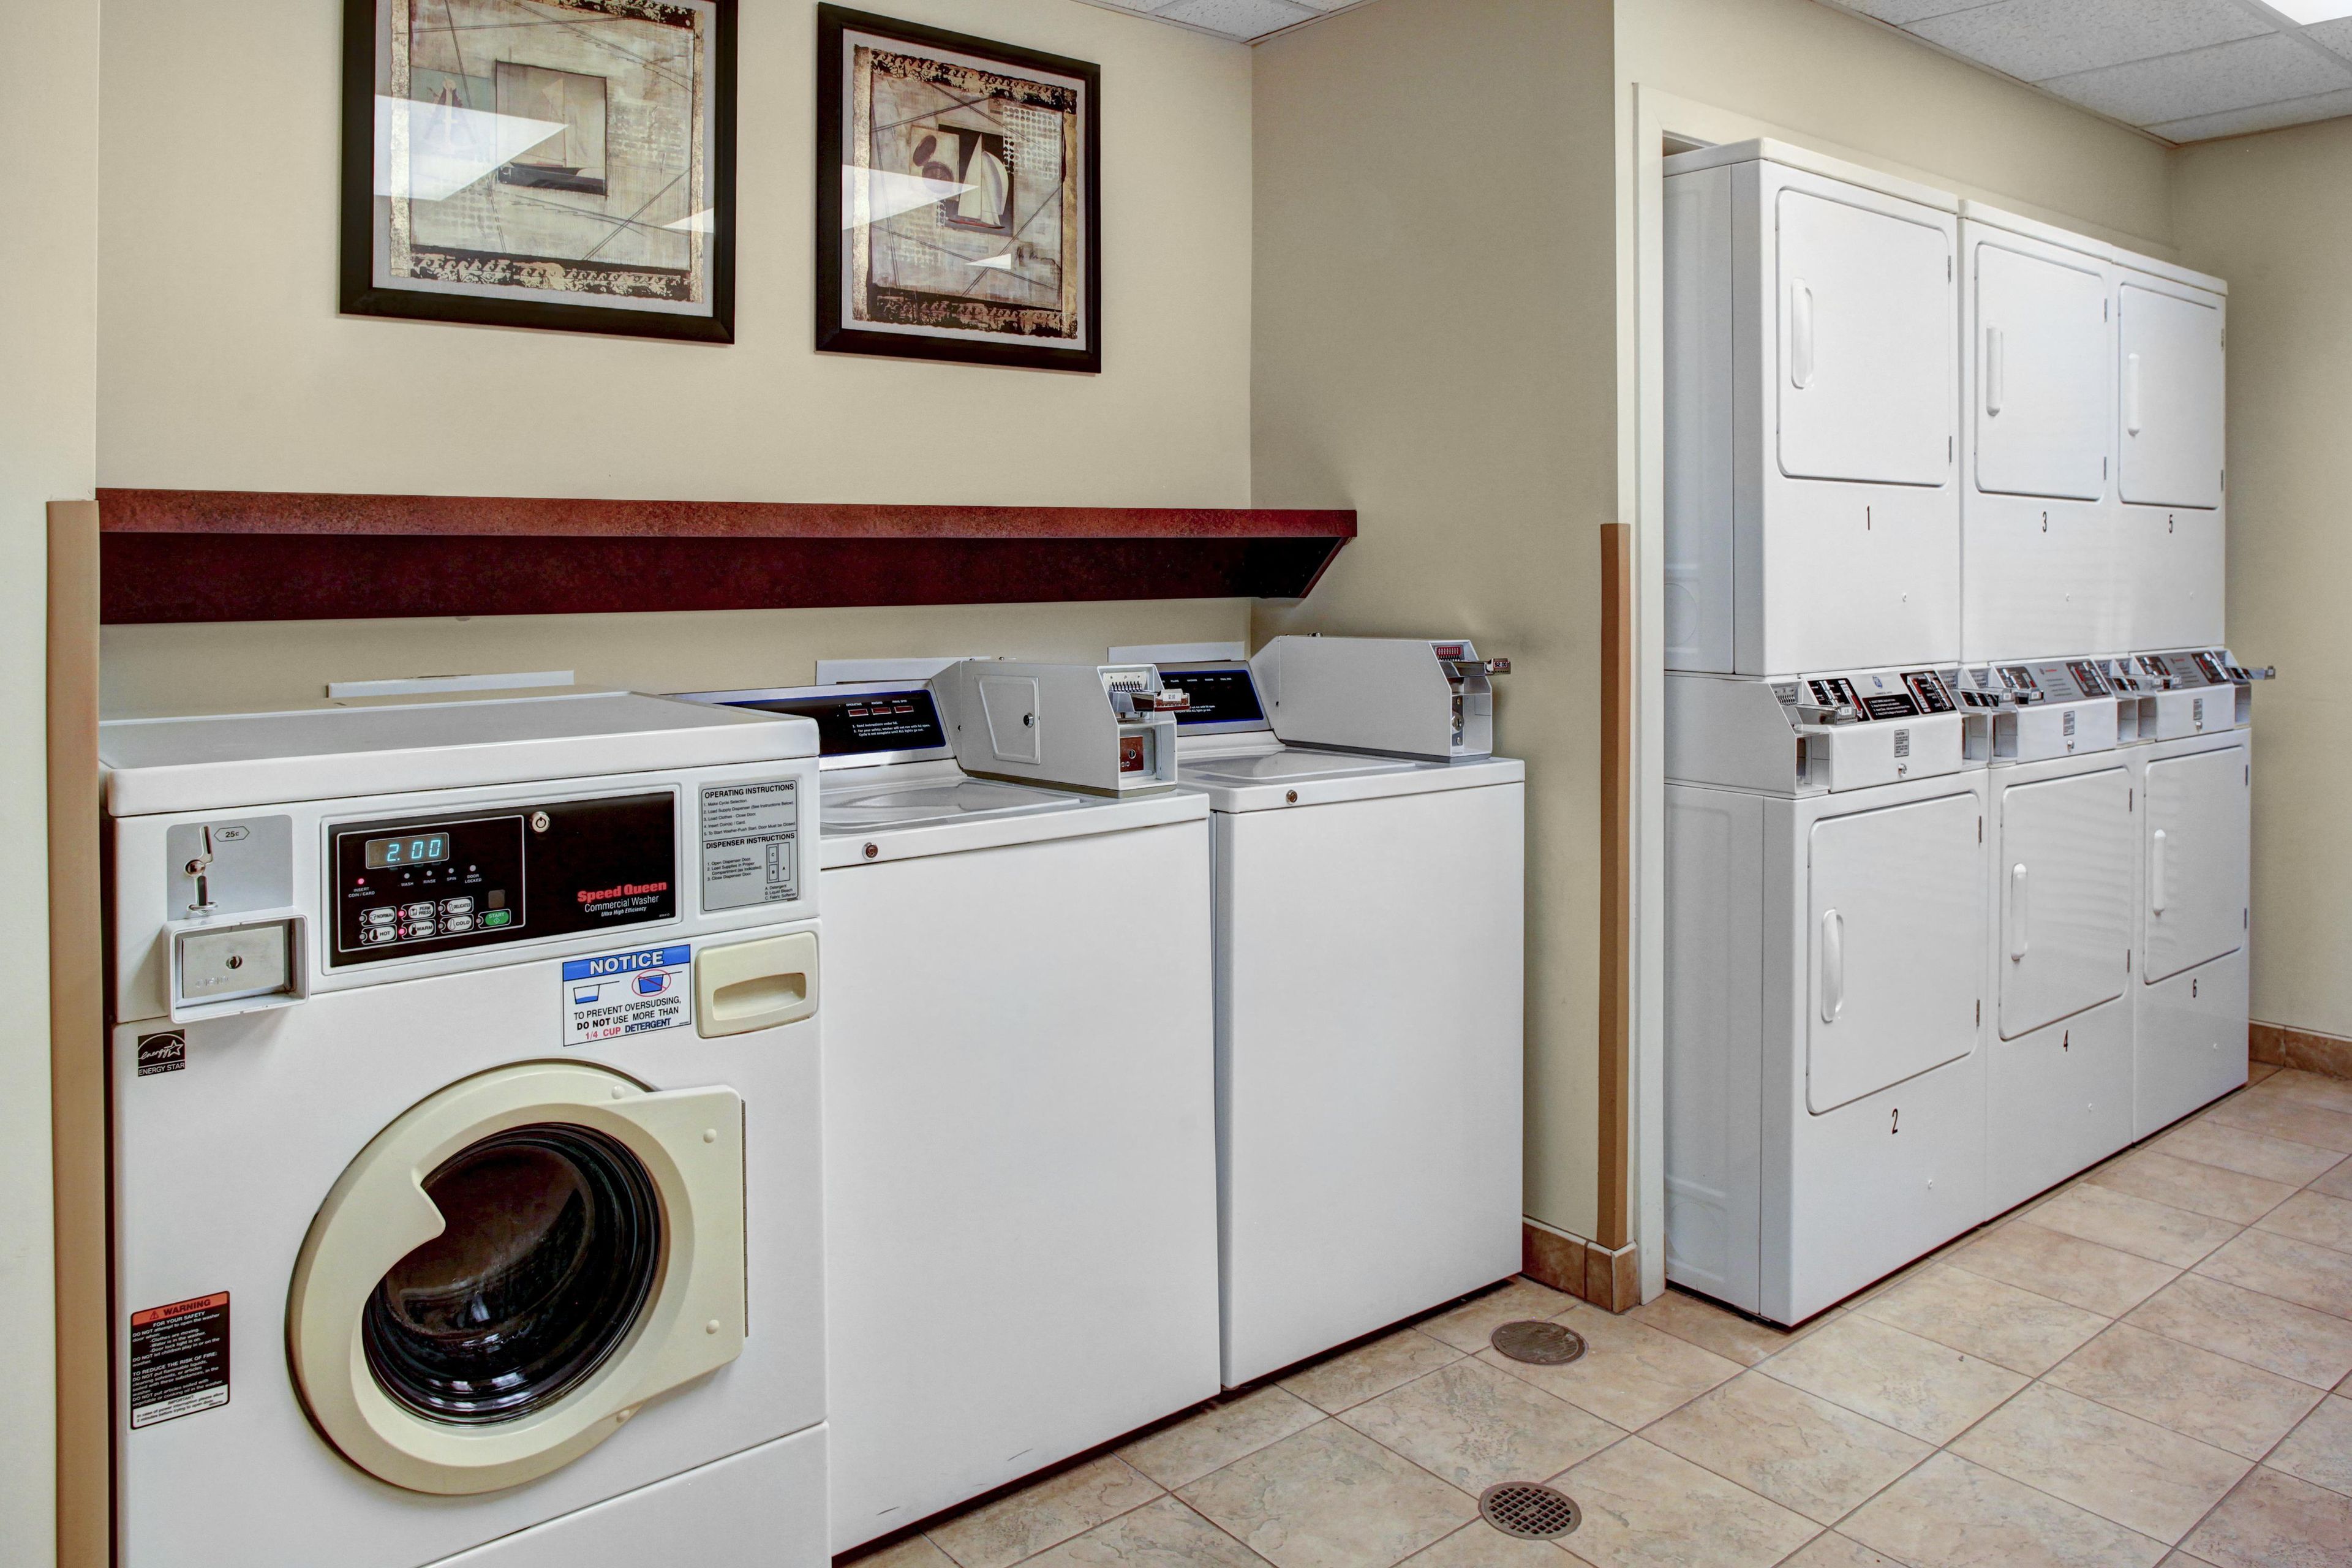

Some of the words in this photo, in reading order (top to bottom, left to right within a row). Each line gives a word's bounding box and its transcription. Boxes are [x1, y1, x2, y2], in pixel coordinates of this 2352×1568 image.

[1866, 505, 1871, 531] 1
[2042, 511, 2048, 533] 3
[2168, 514, 2173, 533] 5
[705, 789, 744, 799] OPERATING
[746, 783, 794, 794] INSTRUCTIONS
[706, 839, 745, 849] DISPENSER
[747, 833, 795, 844] INSTRUCTIONS
[577, 886, 621, 903] Speed
[624, 882, 667, 895] Queen
[584, 898, 630, 913] Commercial
[631, 895, 659, 905] Washer
[590, 951, 664, 975] NOTICE
[2192, 979, 2197, 998] 6
[574, 1012, 584, 1020] TO
[587, 1005, 622, 1018] PREVENT
[577, 1022, 589, 1030] DO
[593, 1018, 611, 1028] NOT
[612, 1014, 628, 1024] USE
[632, 1011, 655, 1020] MORE
[658, 1006, 679, 1017] THAN
[586, 1030, 598, 1040] 1/4
[603, 1027, 621, 1036] CUP
[625, 1018, 671, 1033] DETERGENT
[2063, 1030, 2068, 1052] 4
[138, 1066, 165, 1076] ENERGY
[167, 1062, 185, 1071] STAR
[1891, 1108, 1899, 1134] 2
[163, 1299, 211, 1316] WARNING
[184, 1311, 206, 1320] SAFETY
[142, 1365, 167, 1374] REDUCE
